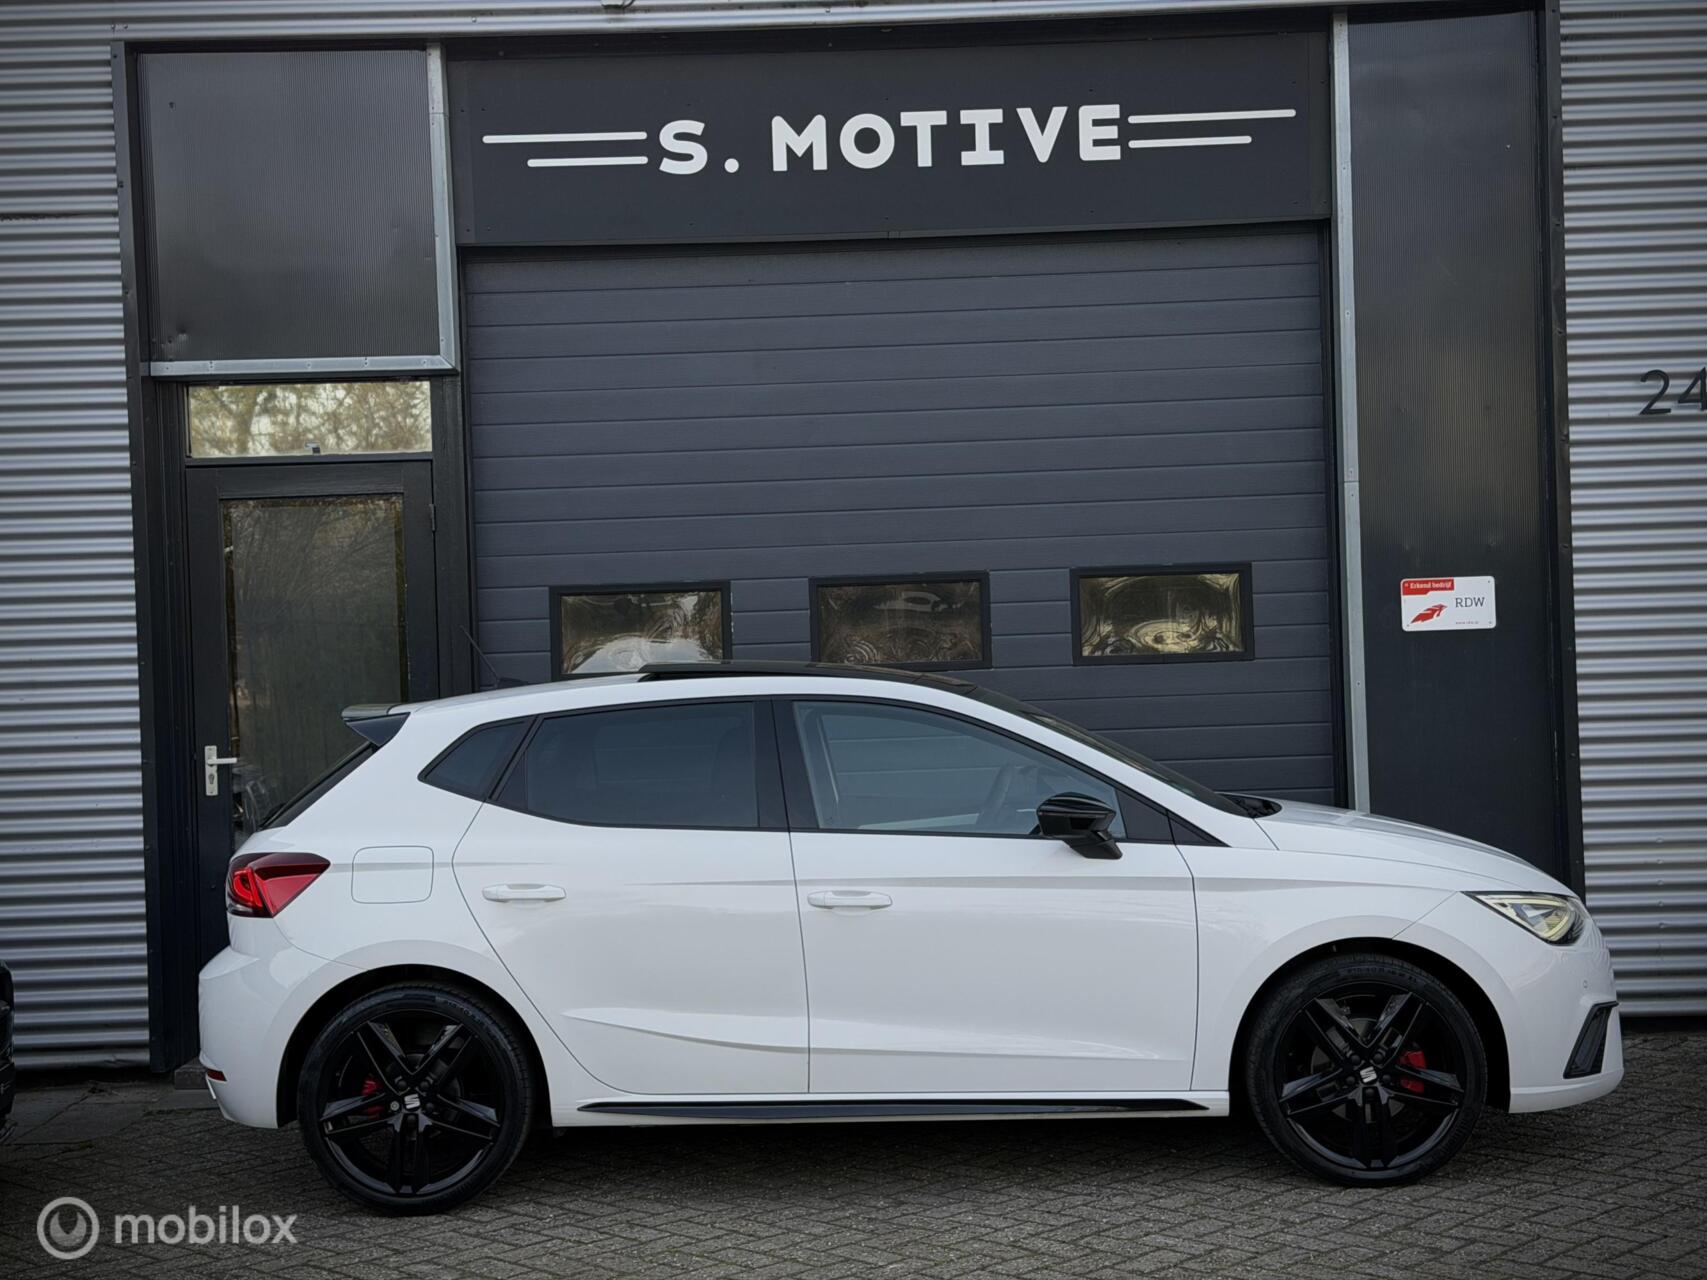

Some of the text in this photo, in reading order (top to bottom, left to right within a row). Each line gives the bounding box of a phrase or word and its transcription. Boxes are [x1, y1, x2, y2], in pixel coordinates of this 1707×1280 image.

[658, 103, 1121, 175] S. MOTIVE
[1639, 367, 1707, 414] 24
[1455, 597, 1485, 608] RDW
